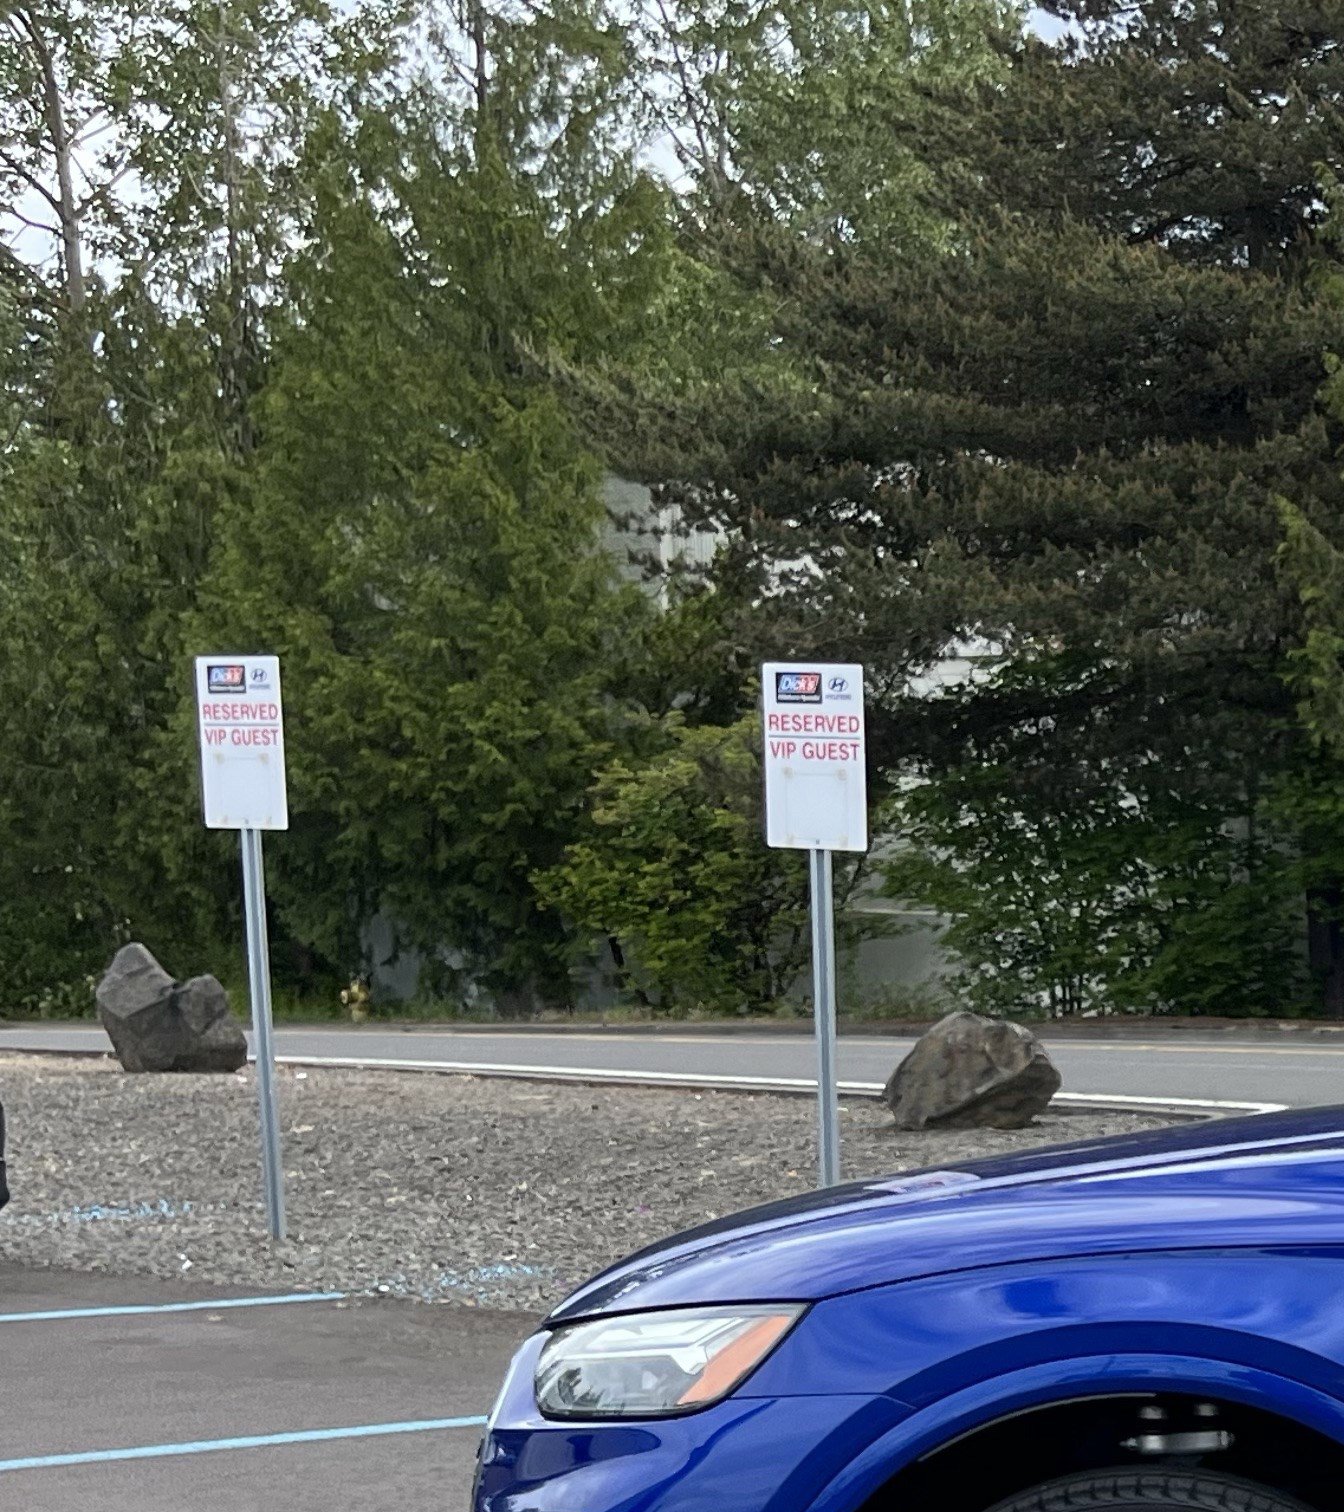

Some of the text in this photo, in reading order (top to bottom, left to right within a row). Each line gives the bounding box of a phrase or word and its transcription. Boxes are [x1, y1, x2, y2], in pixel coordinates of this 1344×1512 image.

[202, 703, 279, 721] RESERVED
[768, 714, 860, 733] RESERVED
[204, 728, 279, 746] VIP GUEST
[769, 741, 861, 761] VIP GUEST
